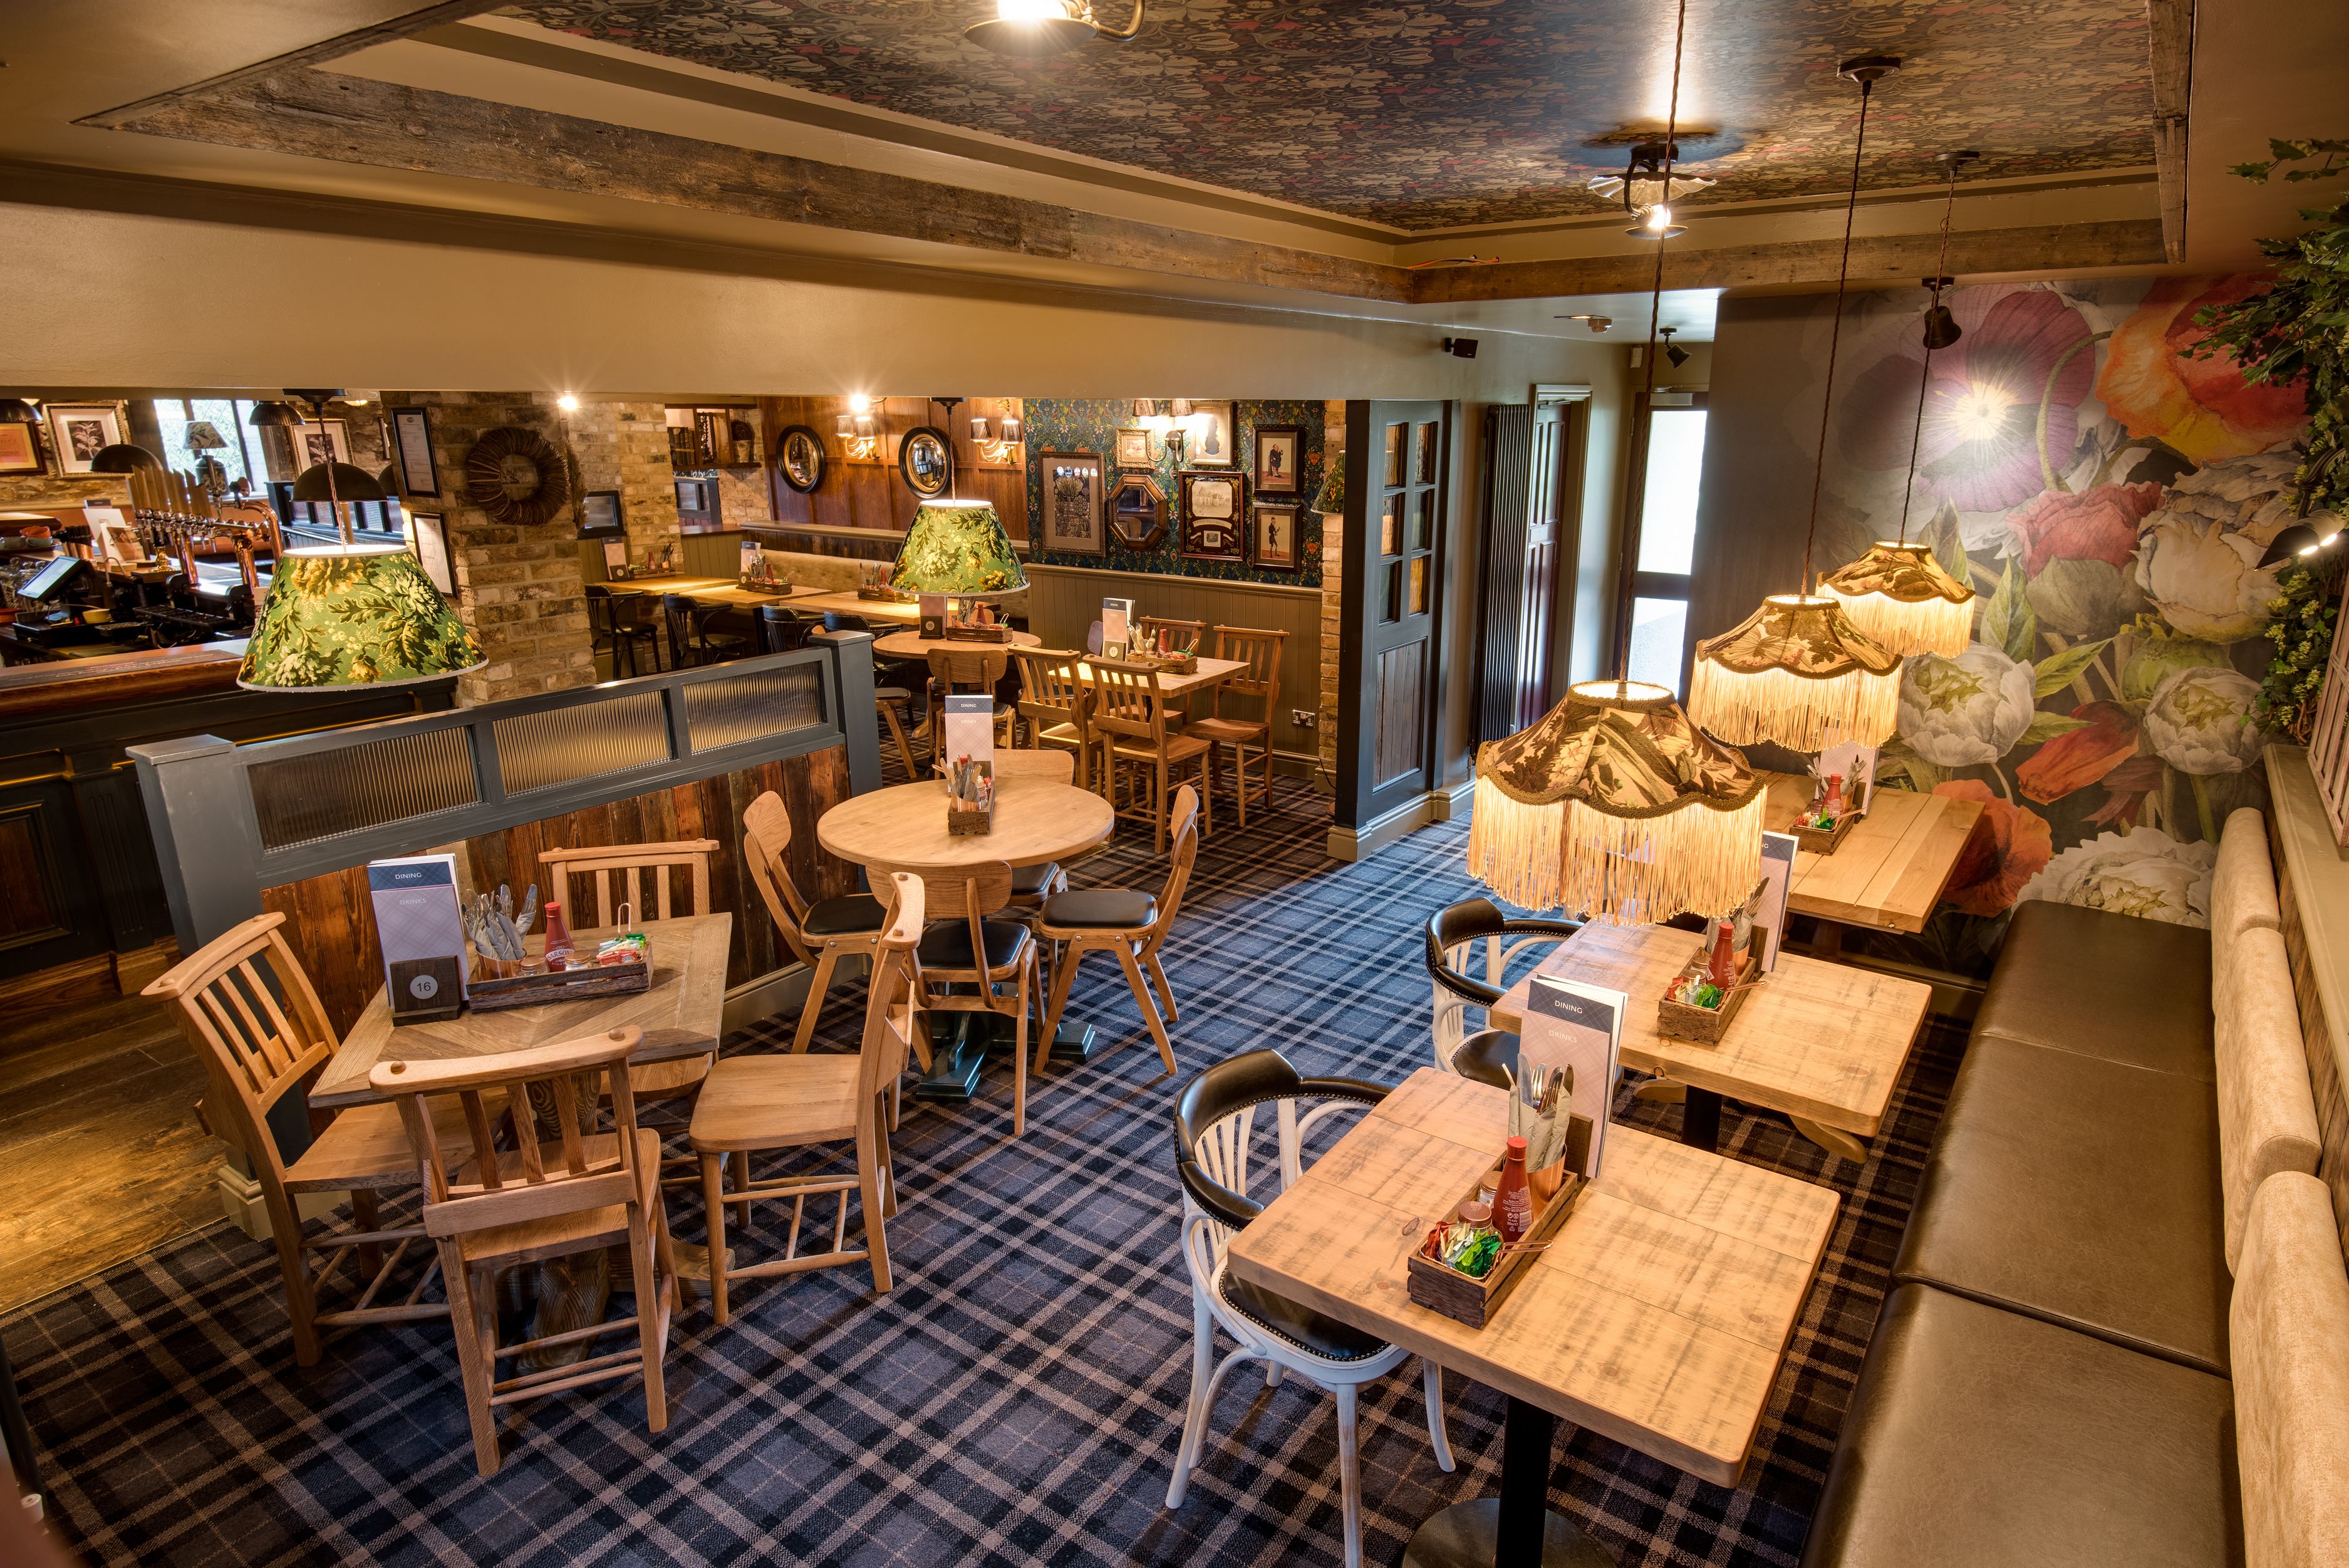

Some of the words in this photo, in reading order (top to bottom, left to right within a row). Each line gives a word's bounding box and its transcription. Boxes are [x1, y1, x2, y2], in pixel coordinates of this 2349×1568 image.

[417, 982, 431, 992] 16
[1555, 1000, 1583, 1014] DINING
[1548, 1030, 1577, 1043] DRINKS
